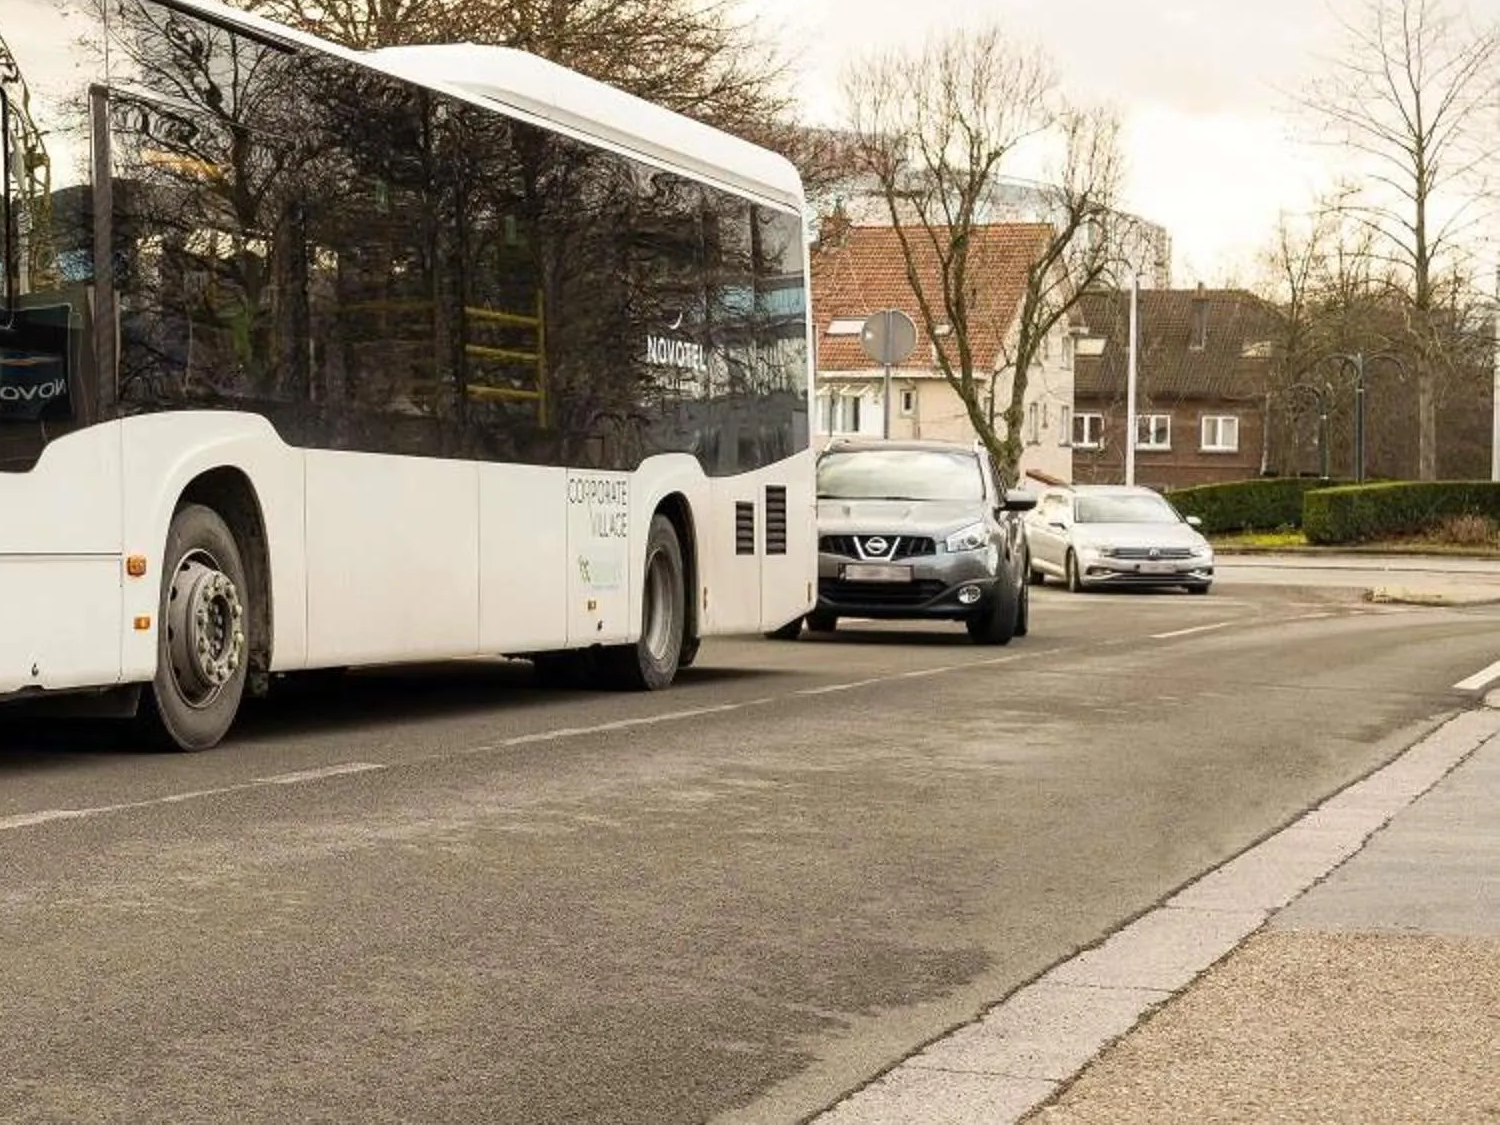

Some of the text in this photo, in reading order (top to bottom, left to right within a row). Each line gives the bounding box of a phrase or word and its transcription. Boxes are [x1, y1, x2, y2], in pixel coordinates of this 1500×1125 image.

[647, 335, 708, 371] NOVOTEL
[567, 478, 627, 506] CORPORATE
[587, 512, 627, 538] VILLAGE
